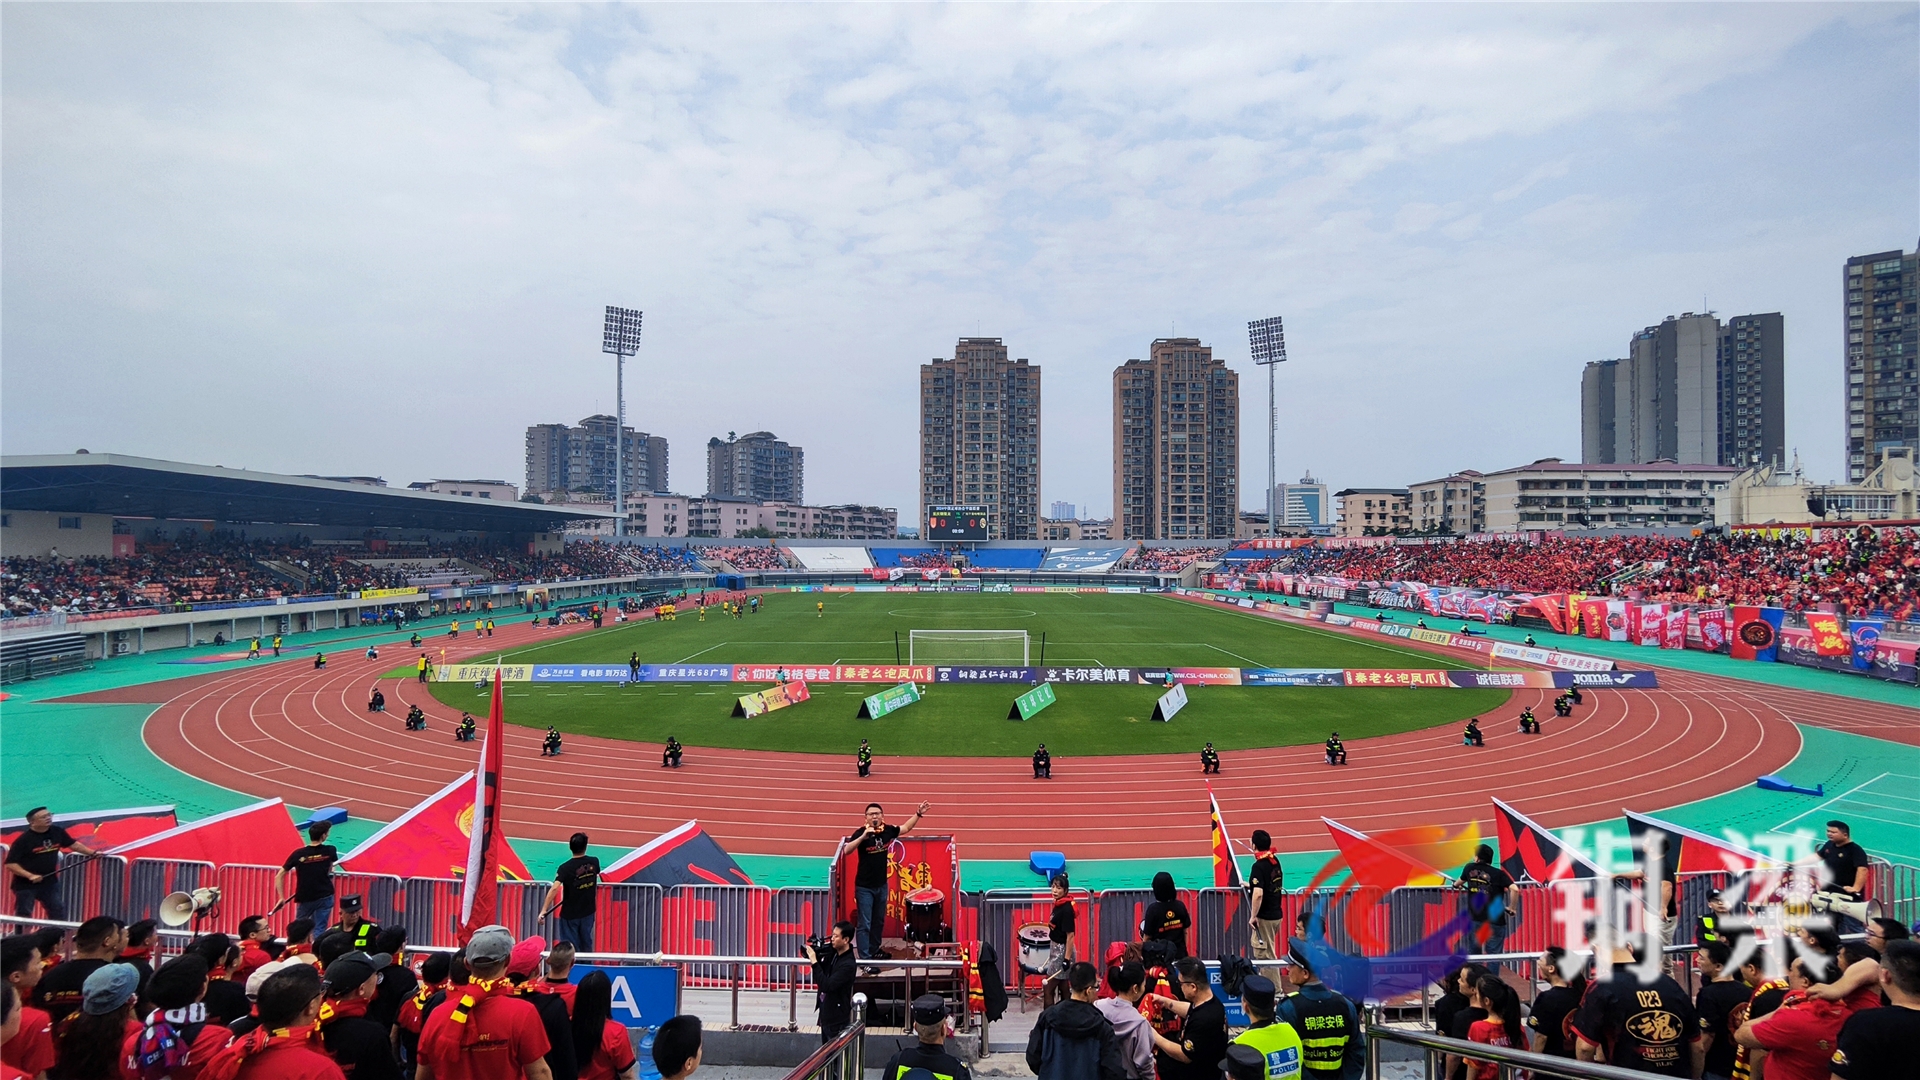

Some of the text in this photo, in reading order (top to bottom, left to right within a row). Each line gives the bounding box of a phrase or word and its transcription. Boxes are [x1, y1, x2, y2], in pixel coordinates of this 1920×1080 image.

[580, 669, 628, 677] 看电影 到万达
[658, 668, 729, 677] 重庆星光68广场
[958, 669, 1028, 679] 铜梁区仁和酒厂
[1061, 668, 1131, 682] 卡尔美体育
[1476, 673, 1526, 686] 诚信联赛
[610, 975, 642, 1018] A
[1636, 990, 1662, 1008] 023
[1304, 1014, 1345, 1031] 铜梁安保
[1637, 1010, 1677, 1040] 魂
[1270, 1047, 1297, 1065] 警察
